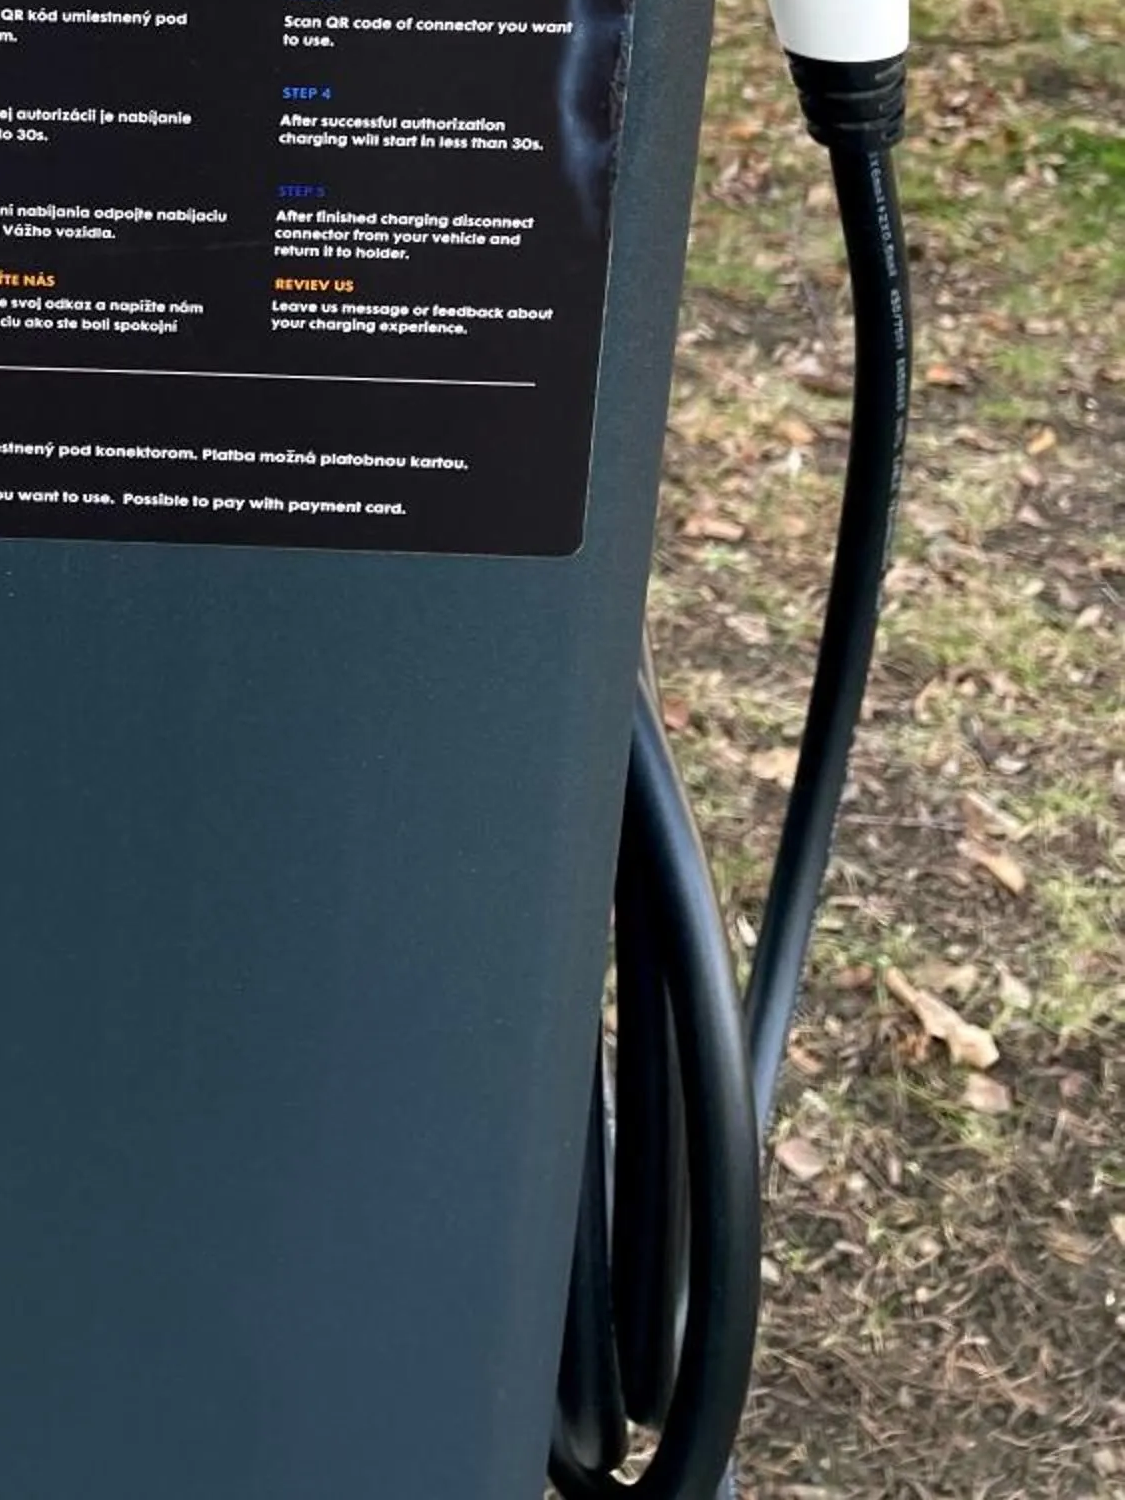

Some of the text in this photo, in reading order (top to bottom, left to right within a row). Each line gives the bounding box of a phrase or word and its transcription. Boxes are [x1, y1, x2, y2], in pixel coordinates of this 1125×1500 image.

[0, 7, 25, 22] QR
[154, 12, 188, 28] pod
[283, 14, 574, 36] Scan QR code of connector you want
[282, 33, 335, 48] to use.
[281, 86, 332, 100] STEP 4
[279, 113, 506, 132] After successful authorization
[15, 128, 49, 142] 30s.
[278, 131, 544, 152] charging will start in less than 30s.
[333, 279, 355, 293] US
[16, 489, 61, 503] want
[61, 490, 80, 504] to
[81, 493, 116, 505] use.
[122, 492, 190, 508] Possible
[191, 494, 210, 508] to
[211, 497, 246, 512] pay
[248, 496, 285, 511] with
[287, 500, 363, 515] payment
[364, 502, 407, 516] card.
